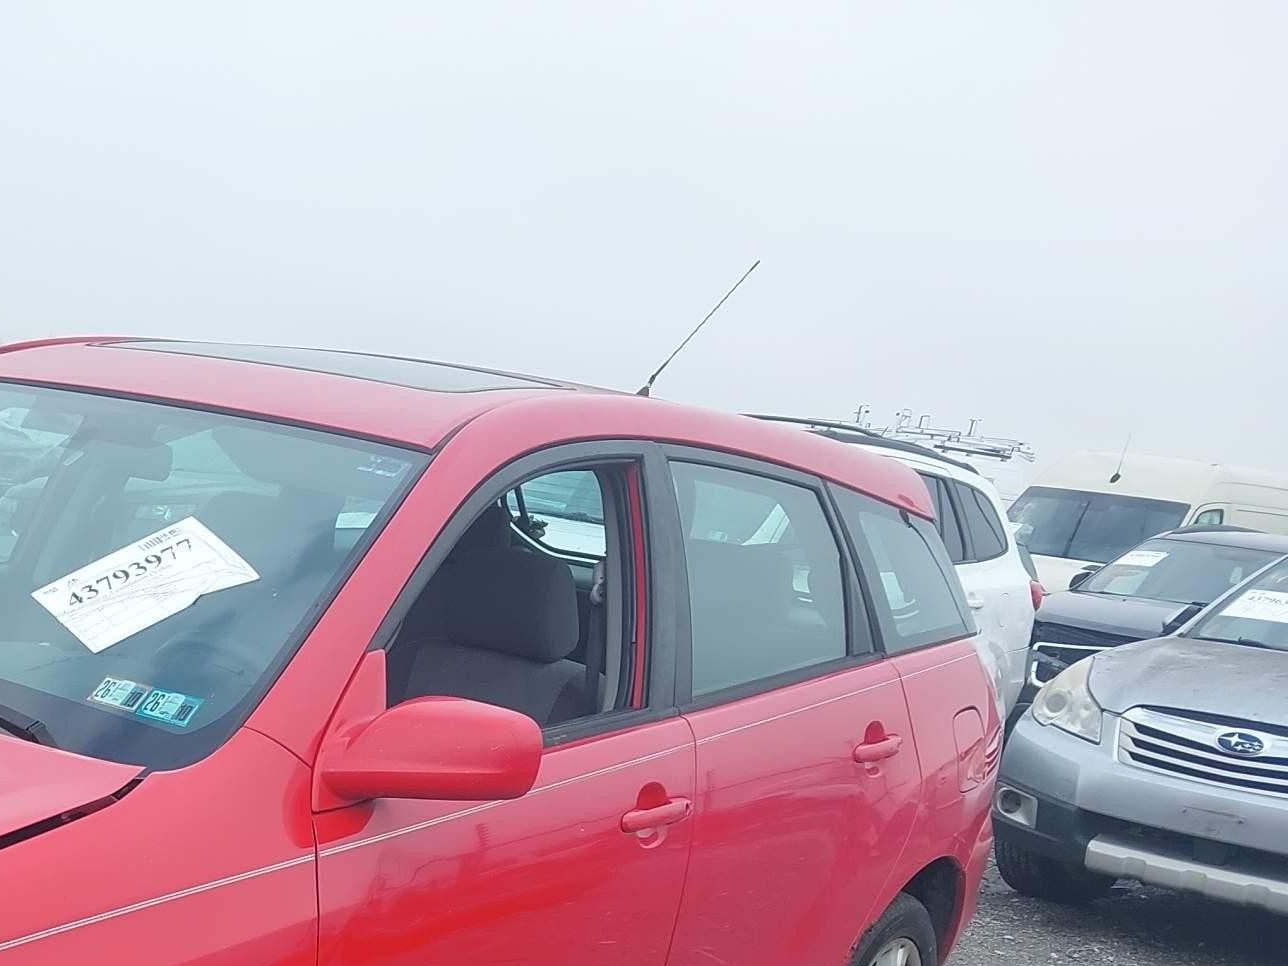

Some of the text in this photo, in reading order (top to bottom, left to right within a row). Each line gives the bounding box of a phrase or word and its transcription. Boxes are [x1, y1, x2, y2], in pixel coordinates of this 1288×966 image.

[68, 538, 192, 607] 43793977
[94, 679, 116, 699] 26
[143, 692, 165, 713] 26
